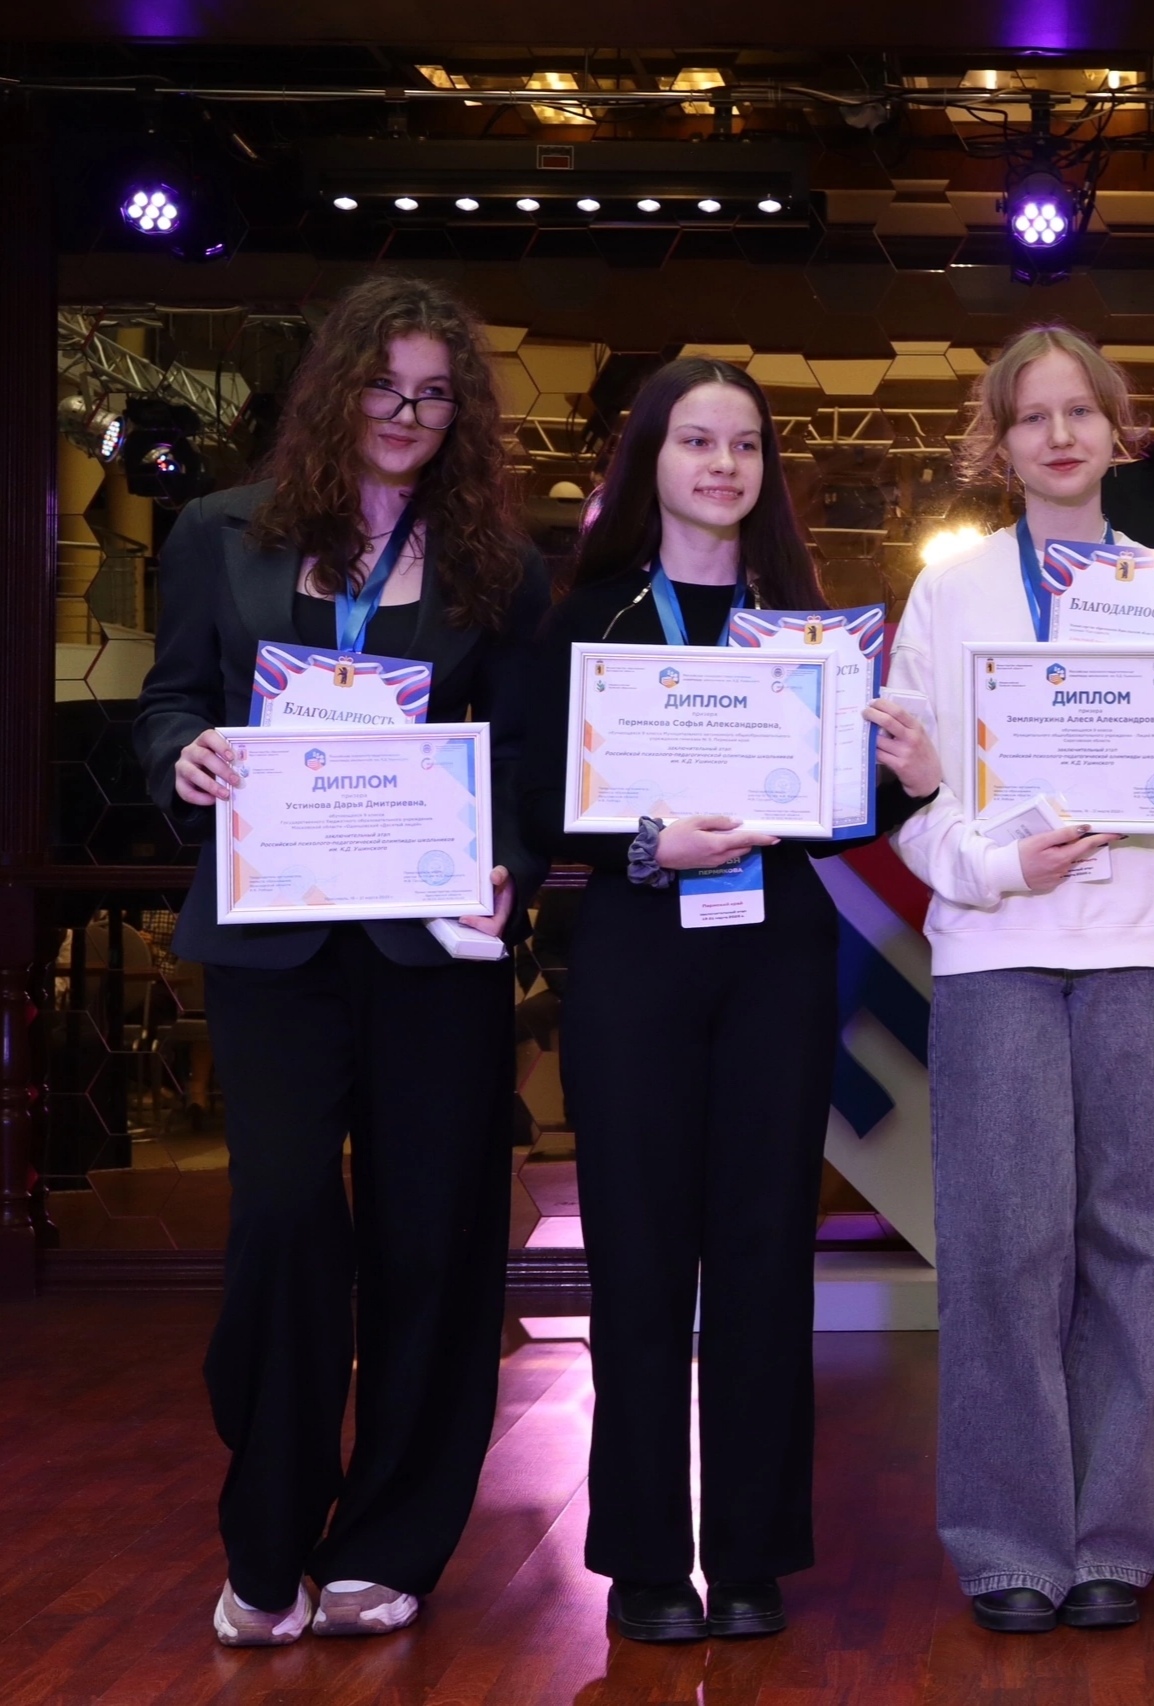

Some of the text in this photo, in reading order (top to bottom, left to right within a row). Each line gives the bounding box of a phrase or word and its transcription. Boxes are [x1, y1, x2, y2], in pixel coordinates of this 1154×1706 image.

[664, 694, 747, 709] ДИПЛОМ
[1052, 691, 1131, 706] ДИПЛОМ
[618, 719, 781, 729] Пермякова Софья Александровна,
[1006, 715, 1065, 723] Землянухина
[1066, 715, 1094, 723] Алеся
[312, 774, 397, 792] ДИПЛОМ
[333, 801, 363, 810] Дарья
[366, 800, 427, 808] Дмитриевна,
